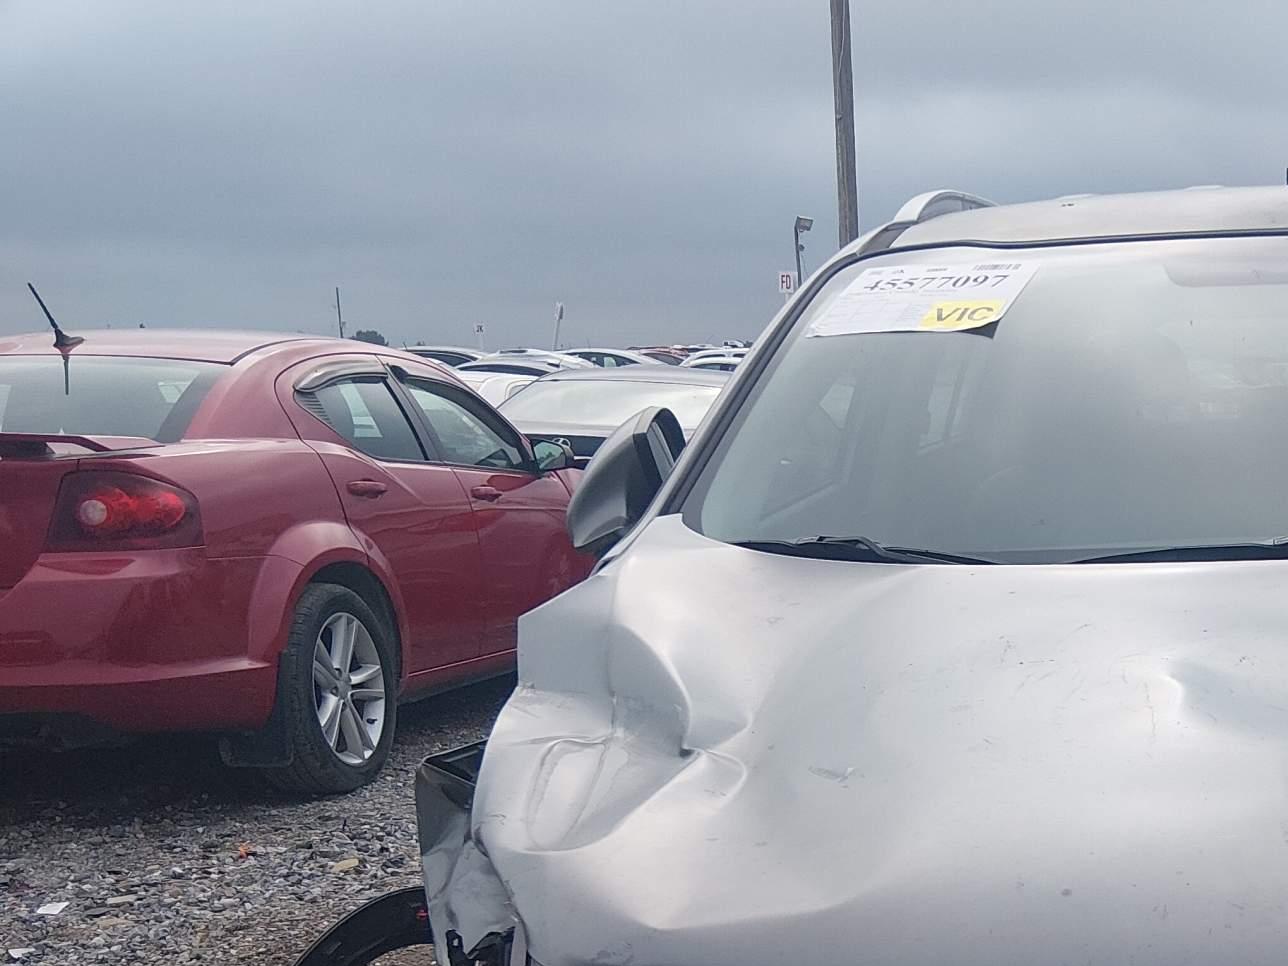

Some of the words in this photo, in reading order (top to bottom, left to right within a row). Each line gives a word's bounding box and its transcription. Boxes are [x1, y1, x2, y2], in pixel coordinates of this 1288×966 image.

[780, 274, 791, 290] FD
[864, 274, 1010, 292] 45577097
[936, 306, 995, 323] VIC
